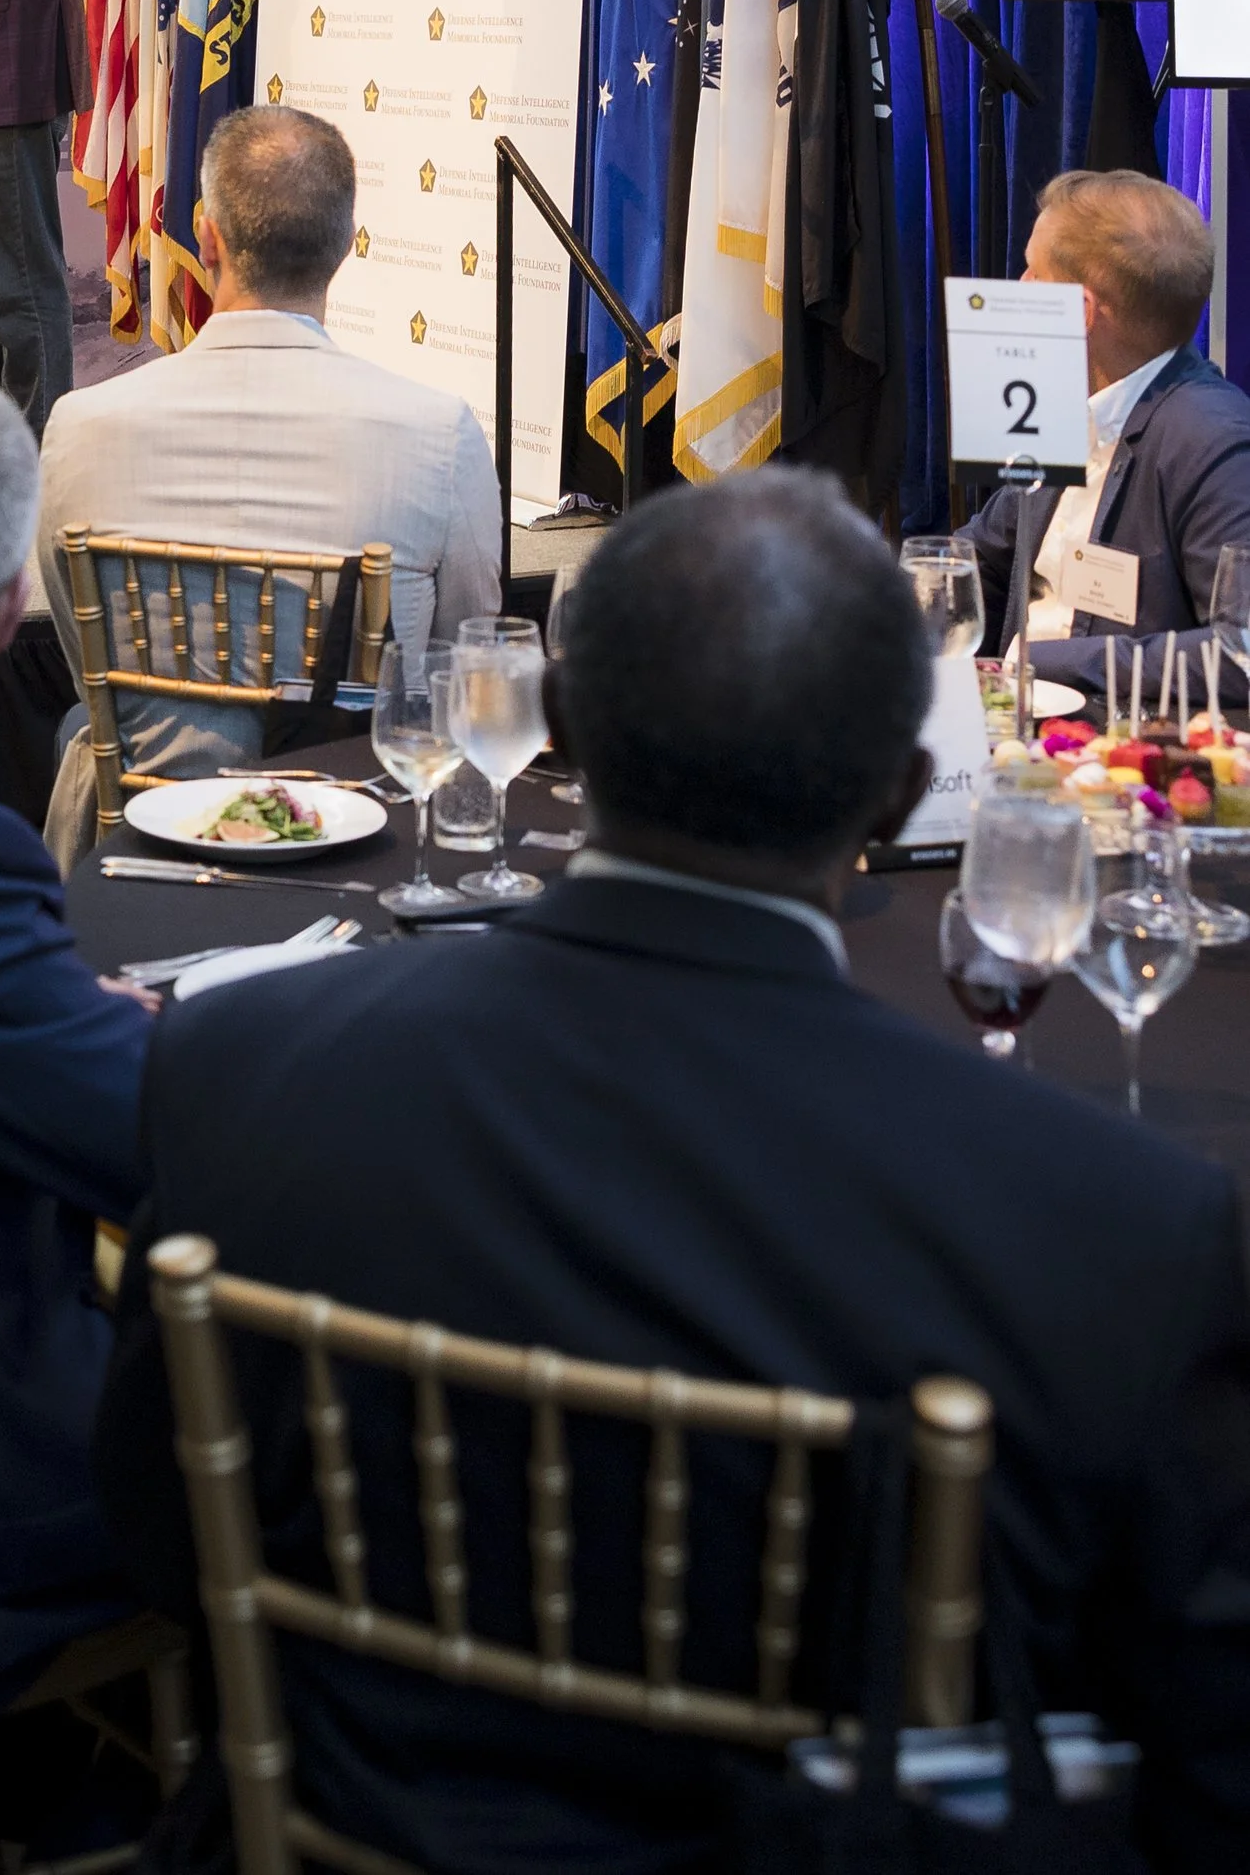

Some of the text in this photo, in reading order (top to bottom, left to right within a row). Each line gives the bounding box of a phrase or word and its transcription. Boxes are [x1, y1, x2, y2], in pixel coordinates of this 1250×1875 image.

[995, 346, 1038, 360] TABLE
[1002, 379, 1040, 435] 2
[512, 419, 553, 438] TELLIGENCE
[512, 437, 552, 455] OUNDATION
